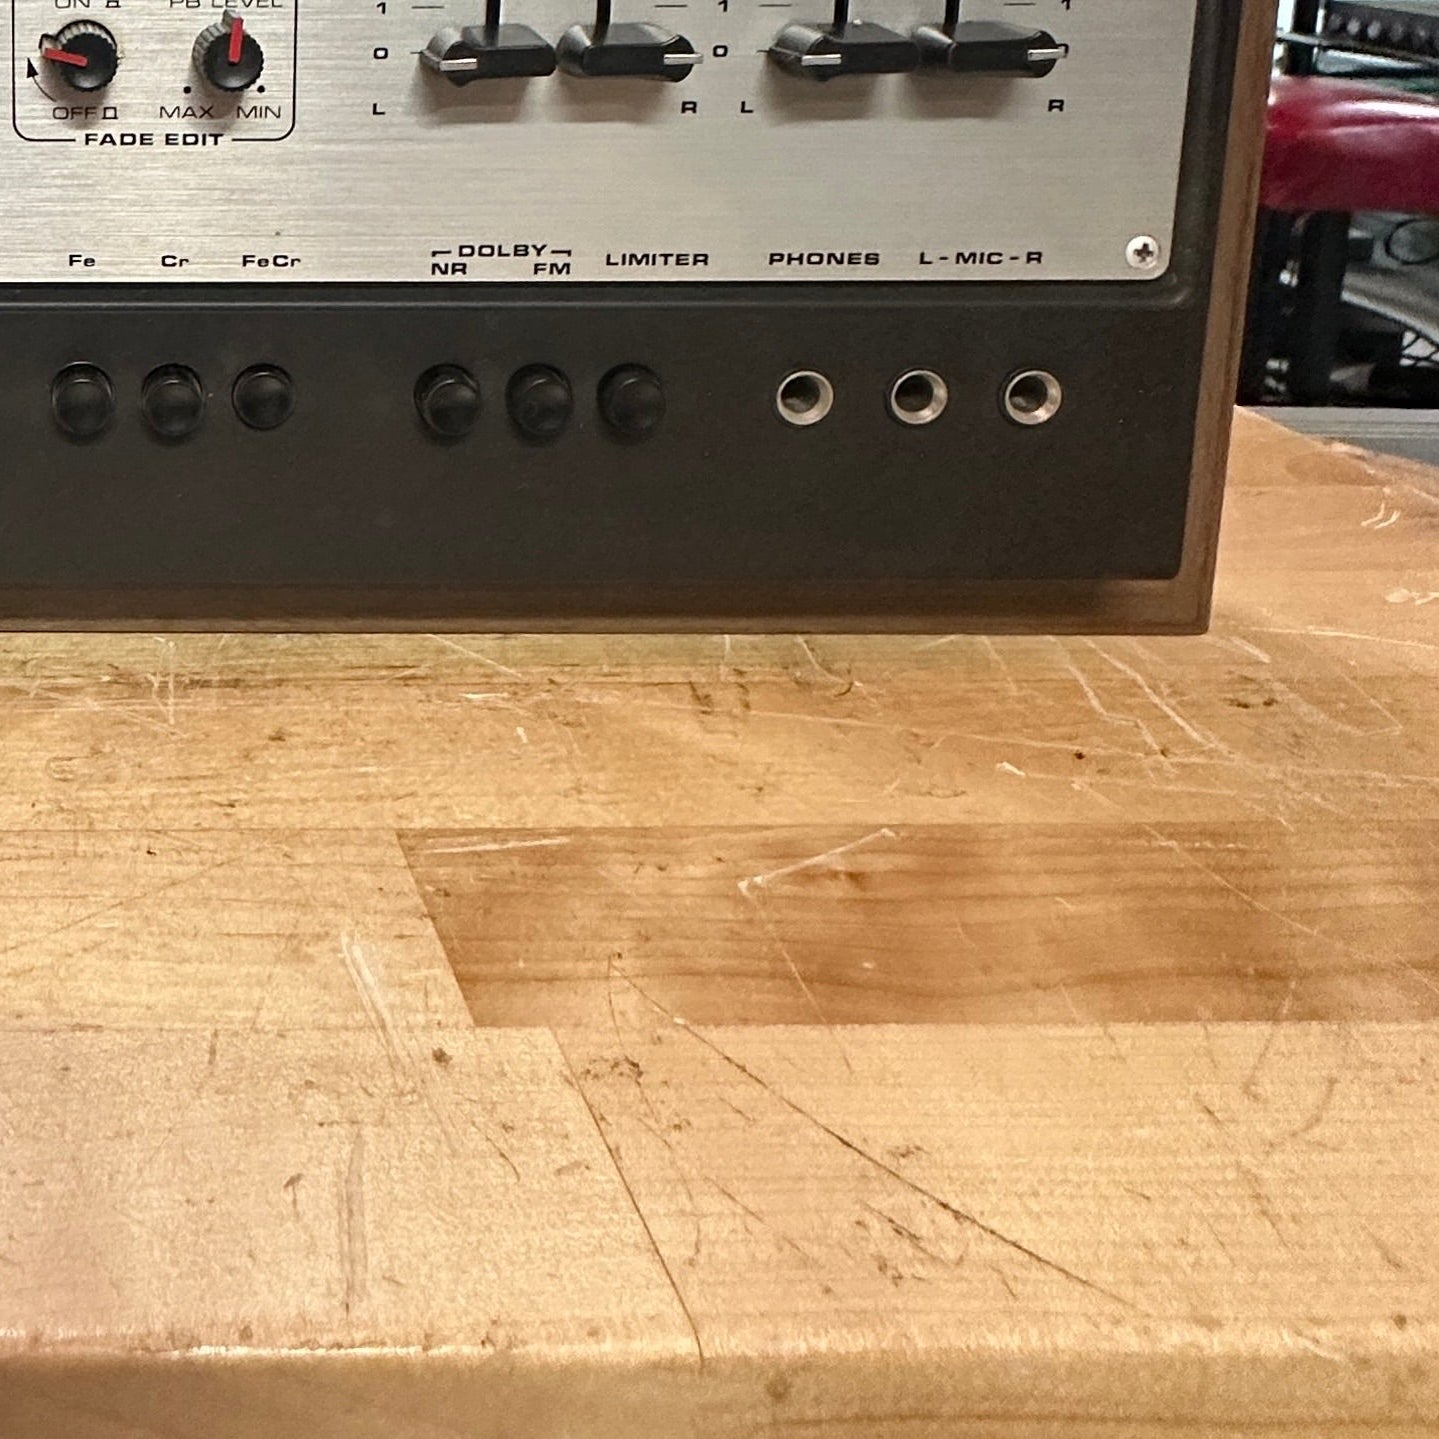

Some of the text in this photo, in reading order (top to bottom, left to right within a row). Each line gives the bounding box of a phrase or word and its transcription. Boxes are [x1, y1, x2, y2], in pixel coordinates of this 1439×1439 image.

[377, 2, 385, 14] 1
[718, 0, 727, 12] 1
[374, 48, 388, 59] 0
[713, 45, 728, 57] 0
[373, 103, 385, 115] L
[681, 101, 697, 113] R
[741, 101, 753, 113] L
[1048, 99, 1064, 112] R
[53, 106, 97, 119] OFF
[160, 106, 213, 119] MAX
[237, 106, 281, 119] MIN
[85, 133, 224, 146] FADE EDIT
[459, 245, 547, 257] DOLBY
[69, 255, 95, 266] Fe
[162, 255, 189, 267] Cr
[606, 254, 708, 265] LIMITER
[769, 253, 879, 265] PHONES
[432, 263, 570, 275] NR FM
